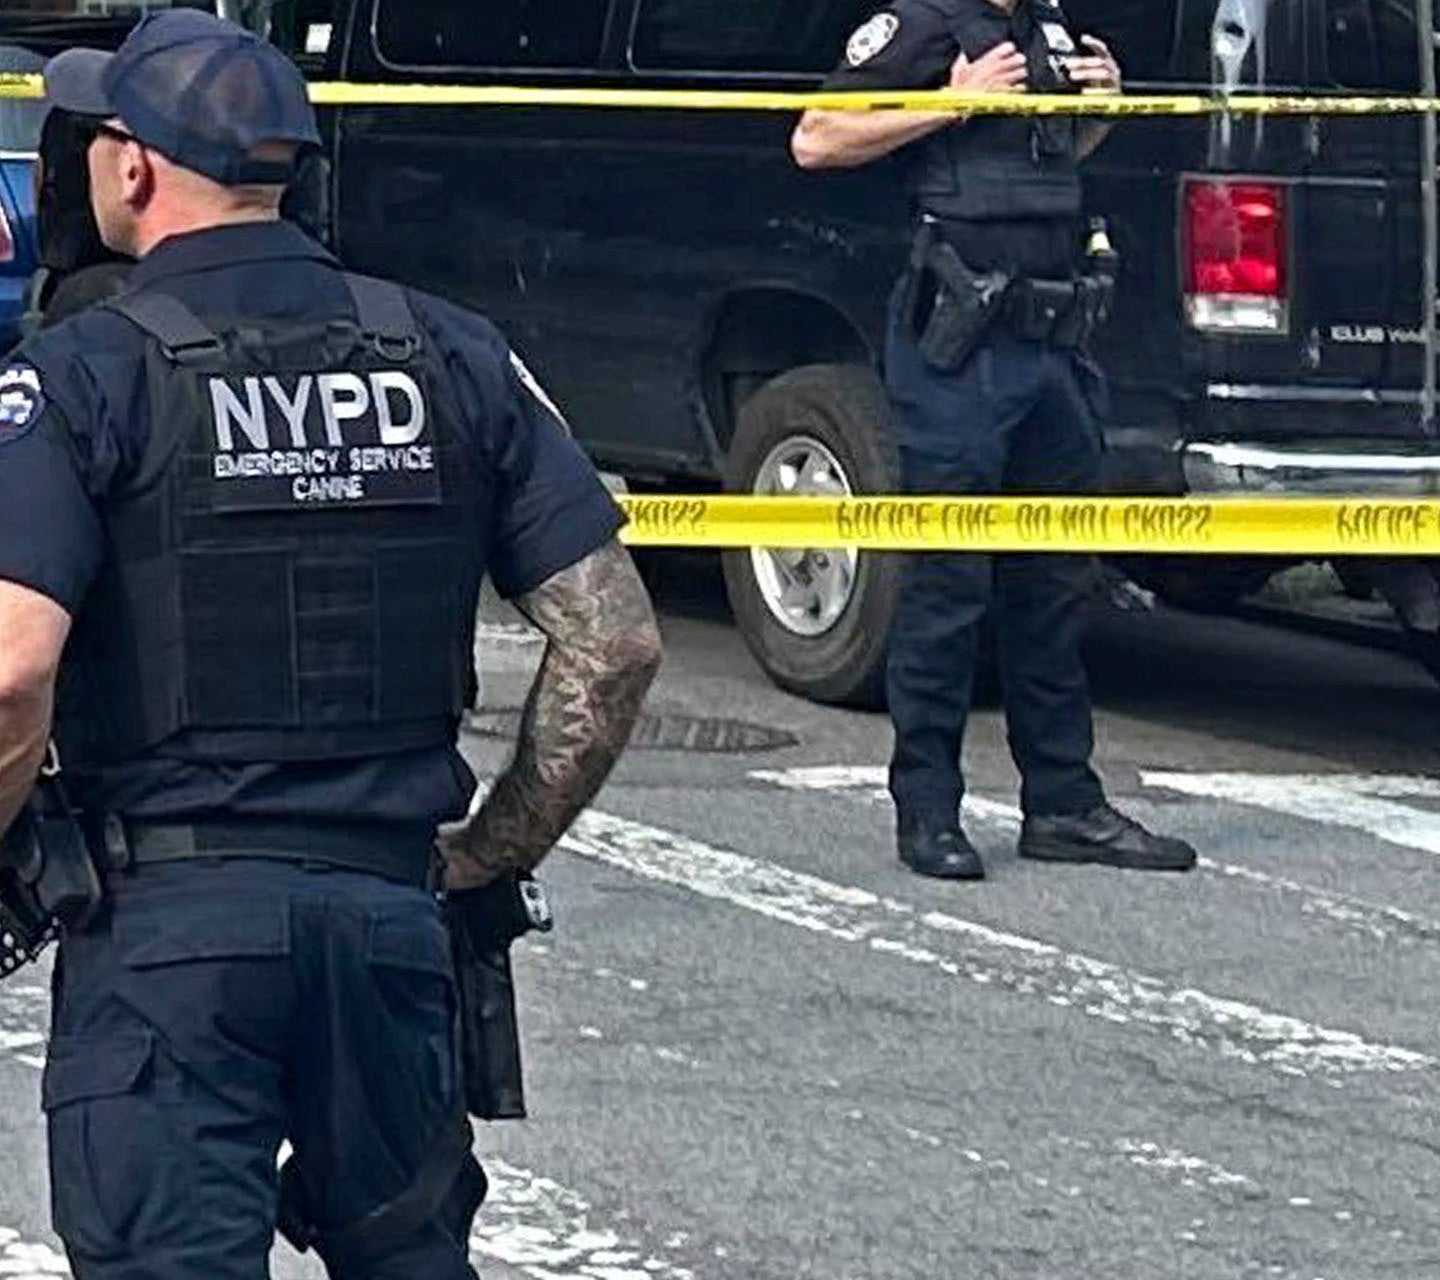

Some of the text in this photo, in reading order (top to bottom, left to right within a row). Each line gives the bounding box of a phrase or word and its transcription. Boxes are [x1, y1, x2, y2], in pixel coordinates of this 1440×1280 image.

[208, 371, 425, 451] NYPD
[213, 446, 435, 479] EMERGENCY SERVICE
[291, 474, 366, 501] CANINE
